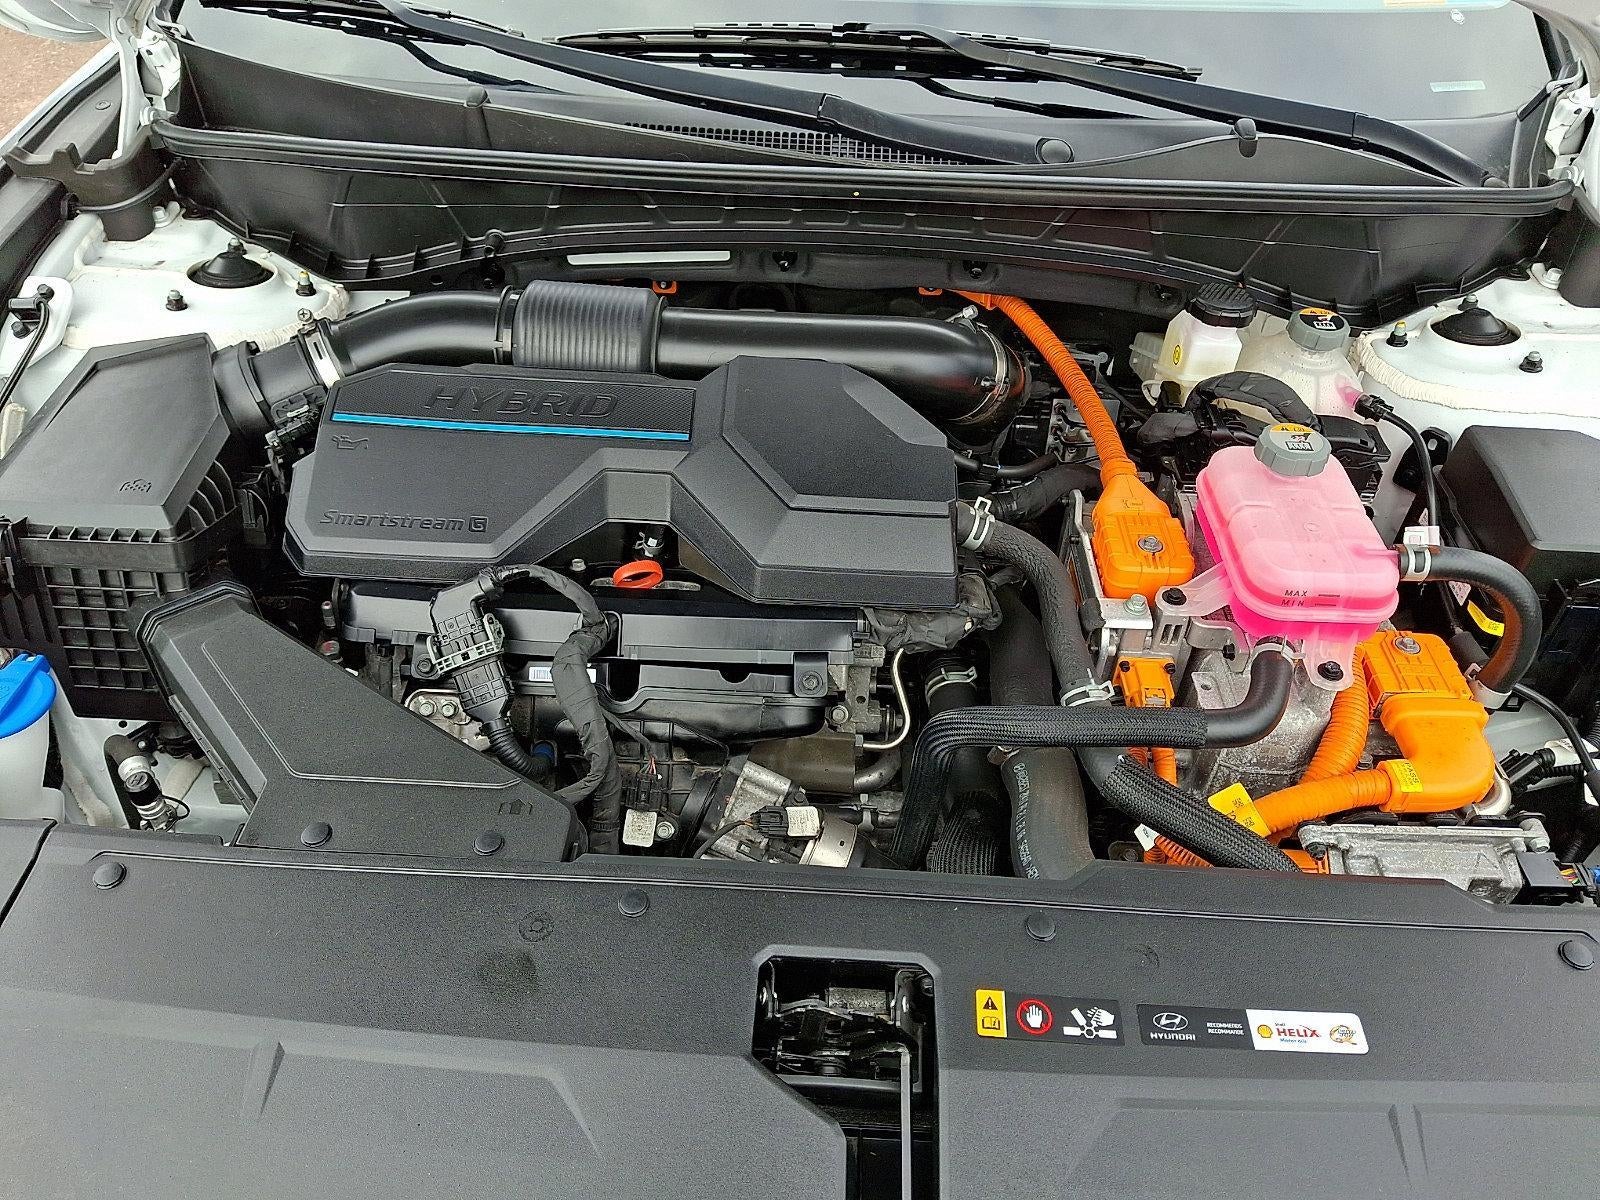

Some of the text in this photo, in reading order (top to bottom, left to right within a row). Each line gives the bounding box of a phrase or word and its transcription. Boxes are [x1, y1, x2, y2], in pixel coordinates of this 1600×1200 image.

[424, 385, 618, 418] HYBRID
[319, 509, 466, 532] Smartstream
[1284, 589, 1308, 597] MAX
[1281, 599, 1305, 607] MIN
[1150, 1031, 1196, 1041] HYUNDAI
[1275, 1027, 1320, 1038] HELIX
